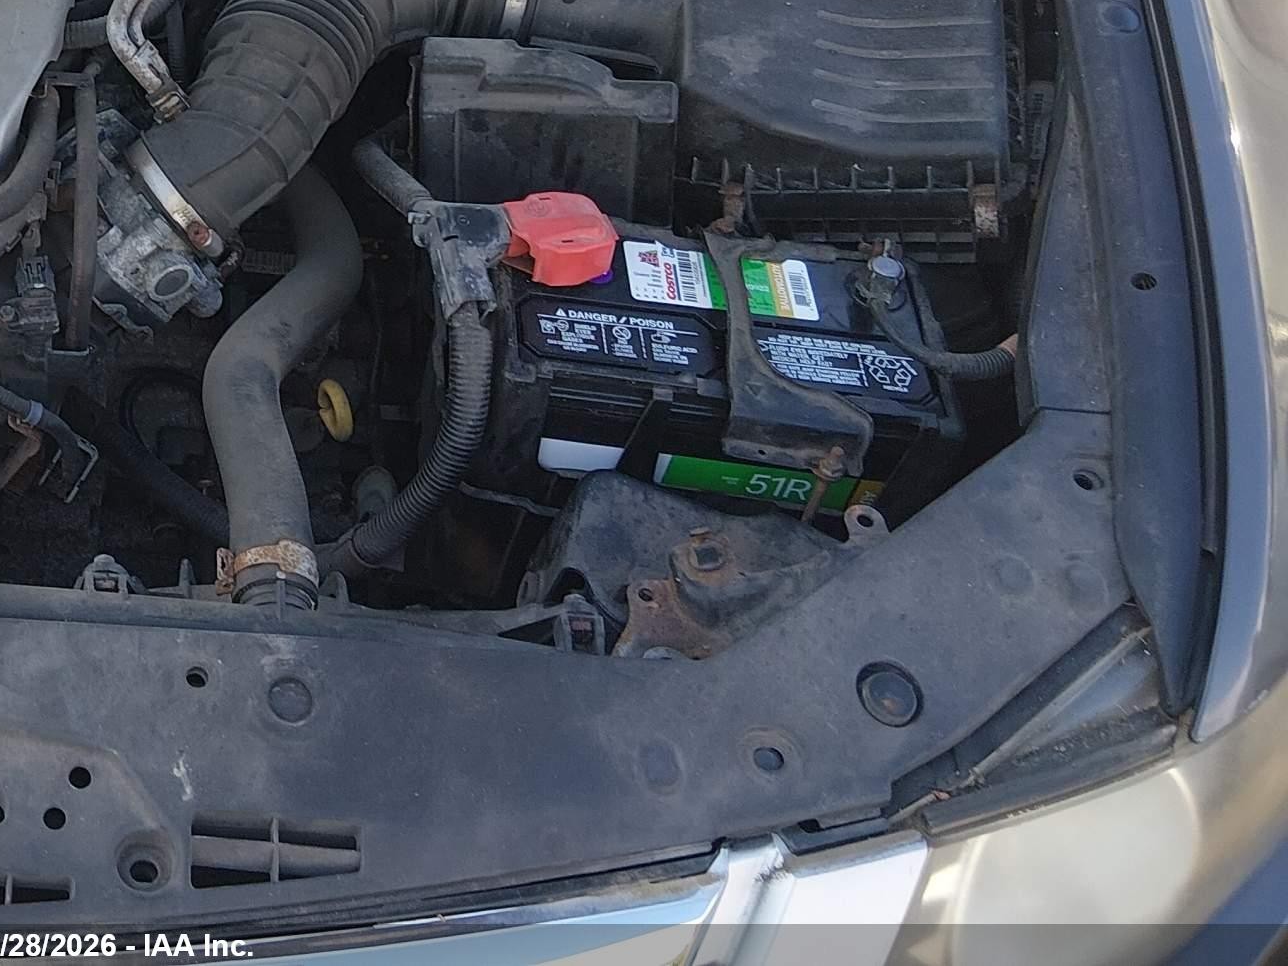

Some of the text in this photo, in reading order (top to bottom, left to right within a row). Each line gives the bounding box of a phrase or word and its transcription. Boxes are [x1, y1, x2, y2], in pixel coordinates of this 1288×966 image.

[663, 261, 677, 301] COSTCO
[568, 309, 617, 323] DANGER
[629, 316, 674, 330] POISON
[745, 473, 812, 501] 51R
